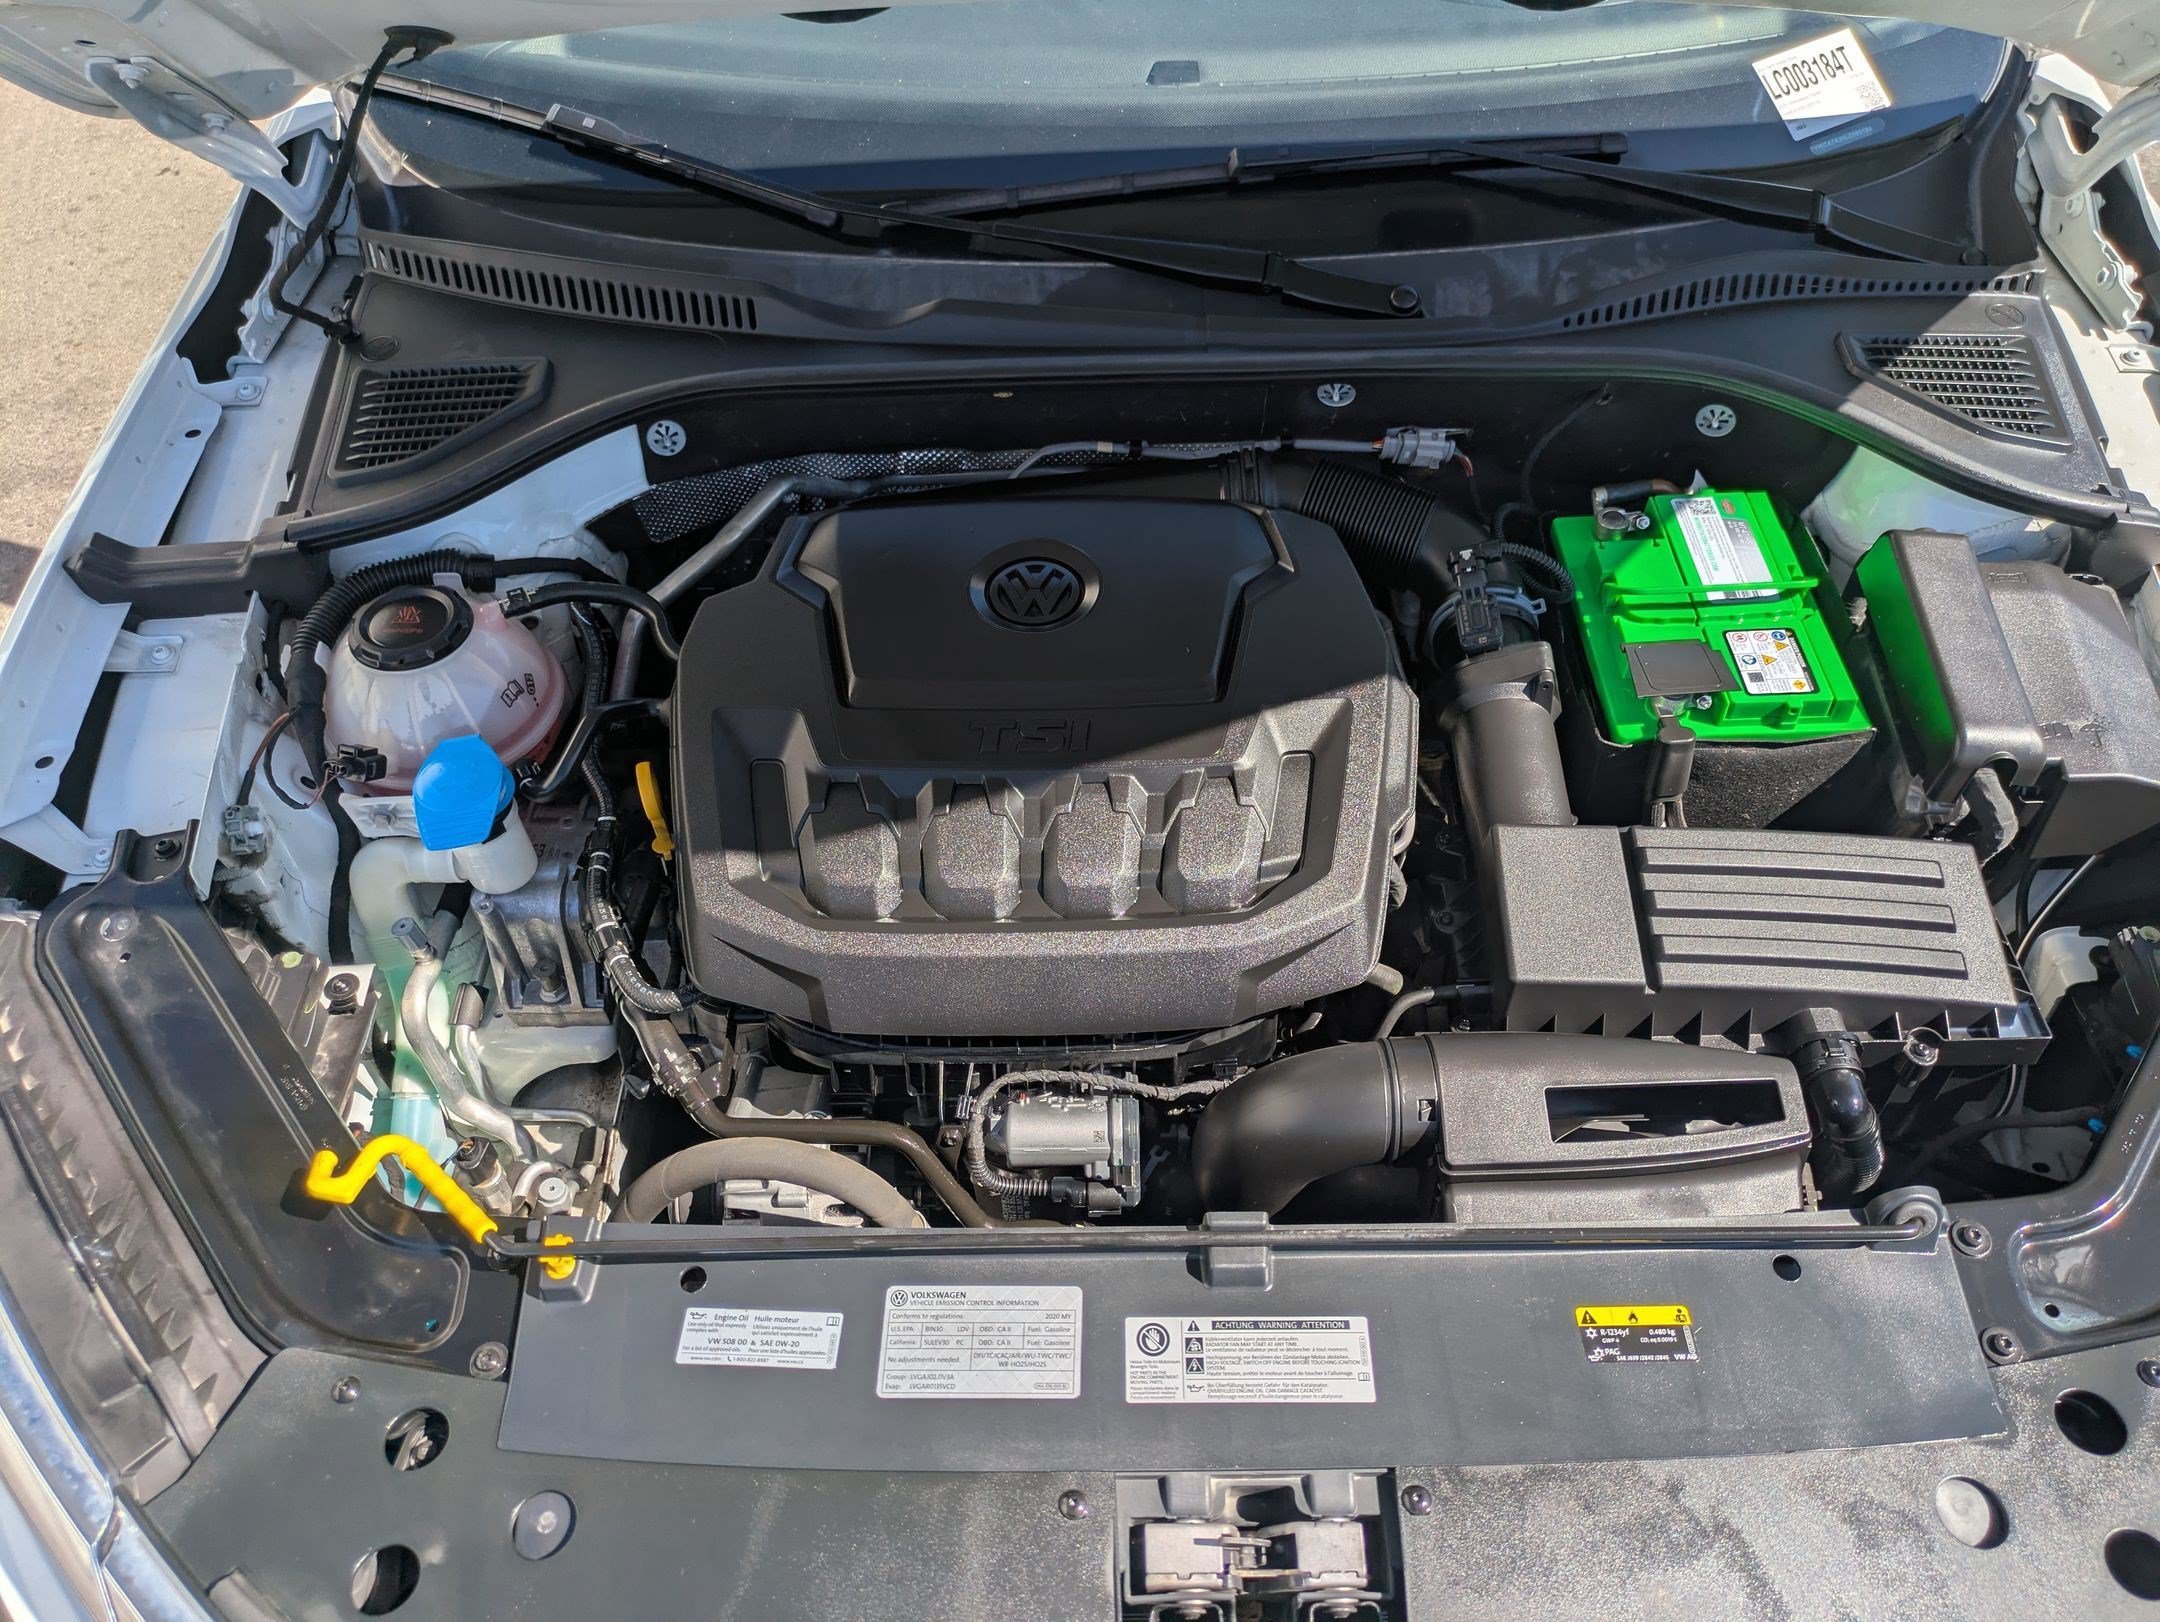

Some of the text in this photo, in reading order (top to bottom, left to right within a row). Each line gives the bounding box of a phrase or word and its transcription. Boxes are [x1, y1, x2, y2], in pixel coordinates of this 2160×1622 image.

[1762, 46, 1853, 100] LC003184T
[969, 718, 1092, 752] TSI
[714, 1313, 738, 1322] Engine
[1600, 1328, 1630, 1337] R-1234yf
[898, 1356, 936, 1364] adjustments
